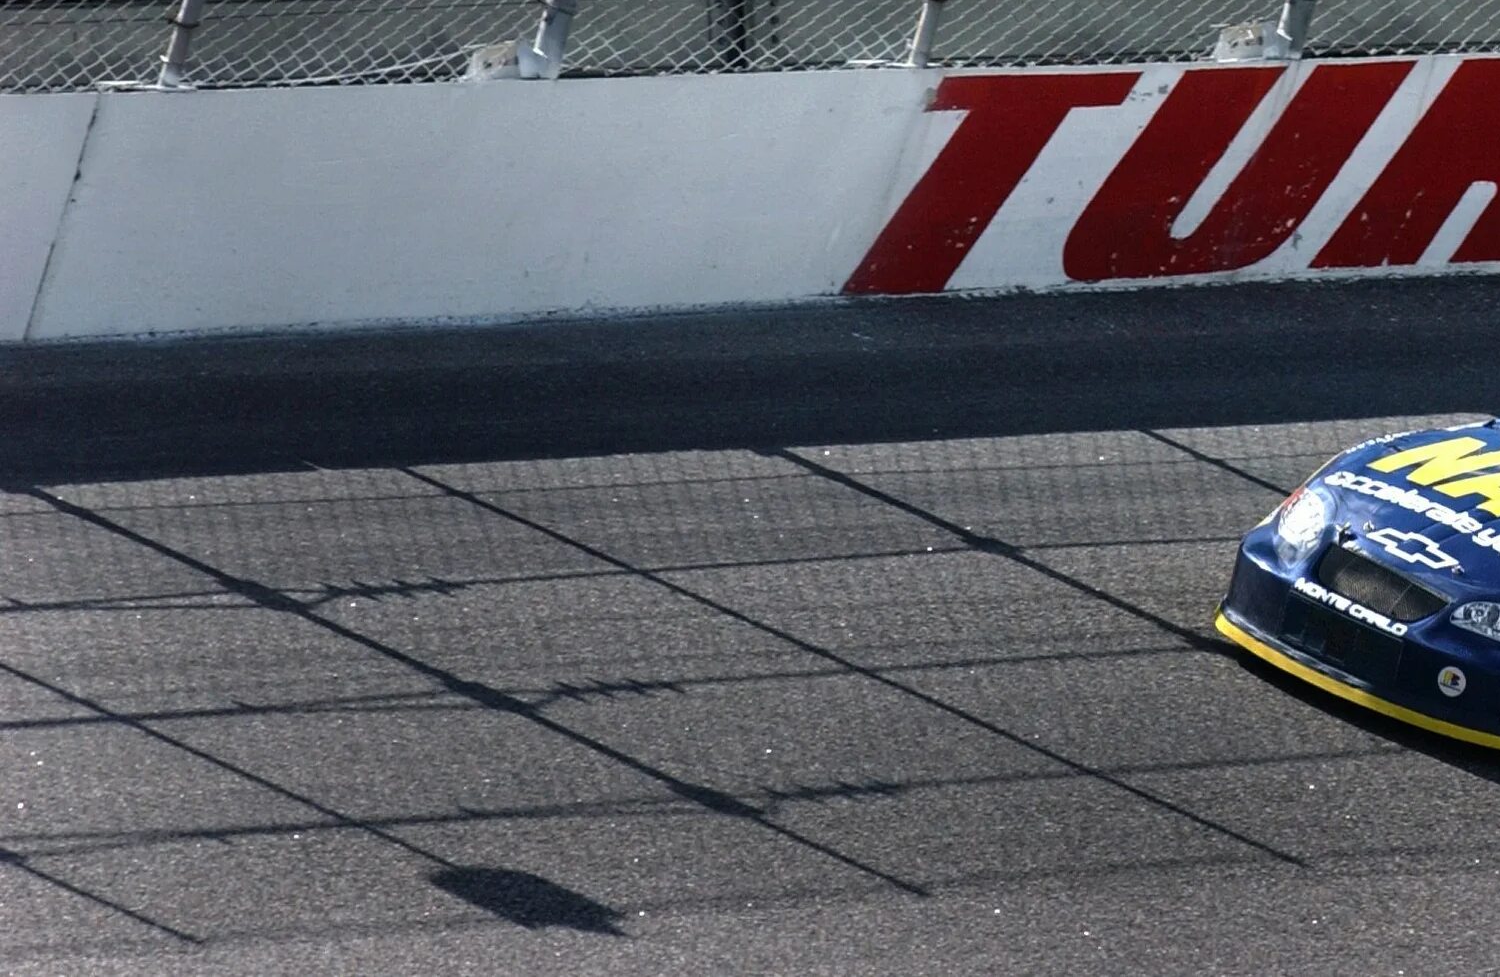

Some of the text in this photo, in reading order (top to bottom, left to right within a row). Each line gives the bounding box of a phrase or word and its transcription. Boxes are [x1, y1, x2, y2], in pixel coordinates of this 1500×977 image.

[1324, 471, 1483, 534] accelerate
[1294, 577, 1409, 637] MONTE CARLO
